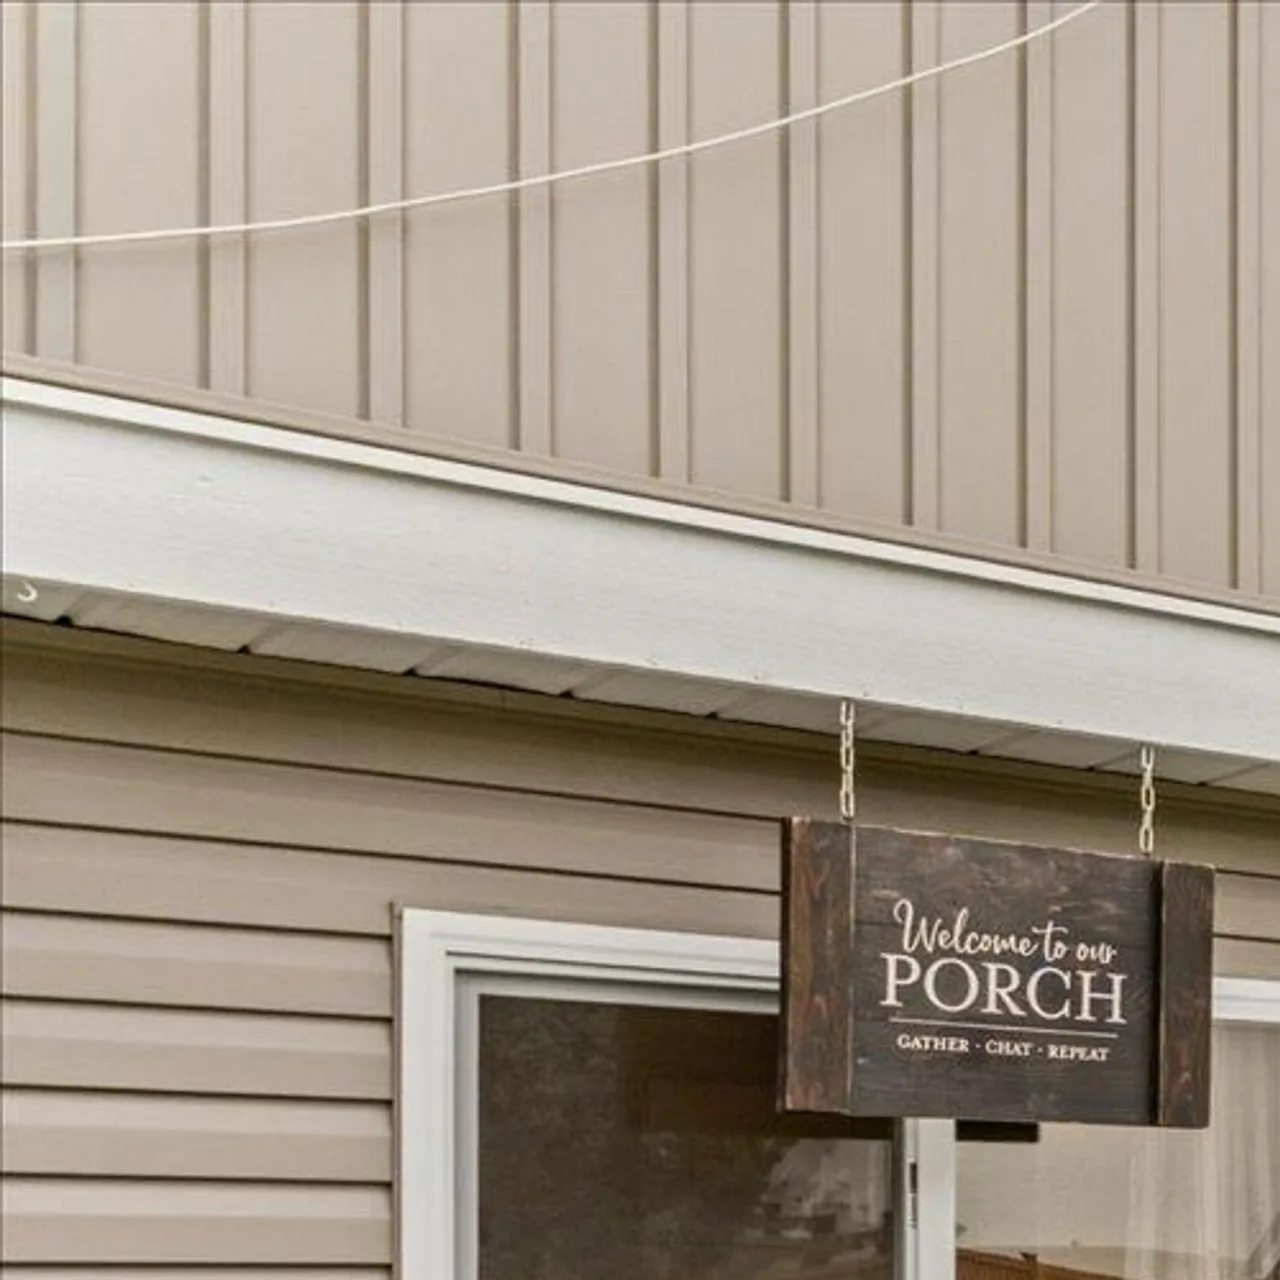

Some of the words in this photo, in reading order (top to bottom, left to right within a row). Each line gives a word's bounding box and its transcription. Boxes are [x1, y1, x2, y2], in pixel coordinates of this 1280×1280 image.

[893, 898, 1037, 955] Welcome
[1032, 920, 1068, 962] to
[1075, 940, 1117, 964] our
[879, 952, 1128, 1025] PORCH
[897, 1034, 970, 1052] GATHER
[985, 1039, 1034, 1057] CHAT
[1047, 1044, 1110, 1062] REPEAT
